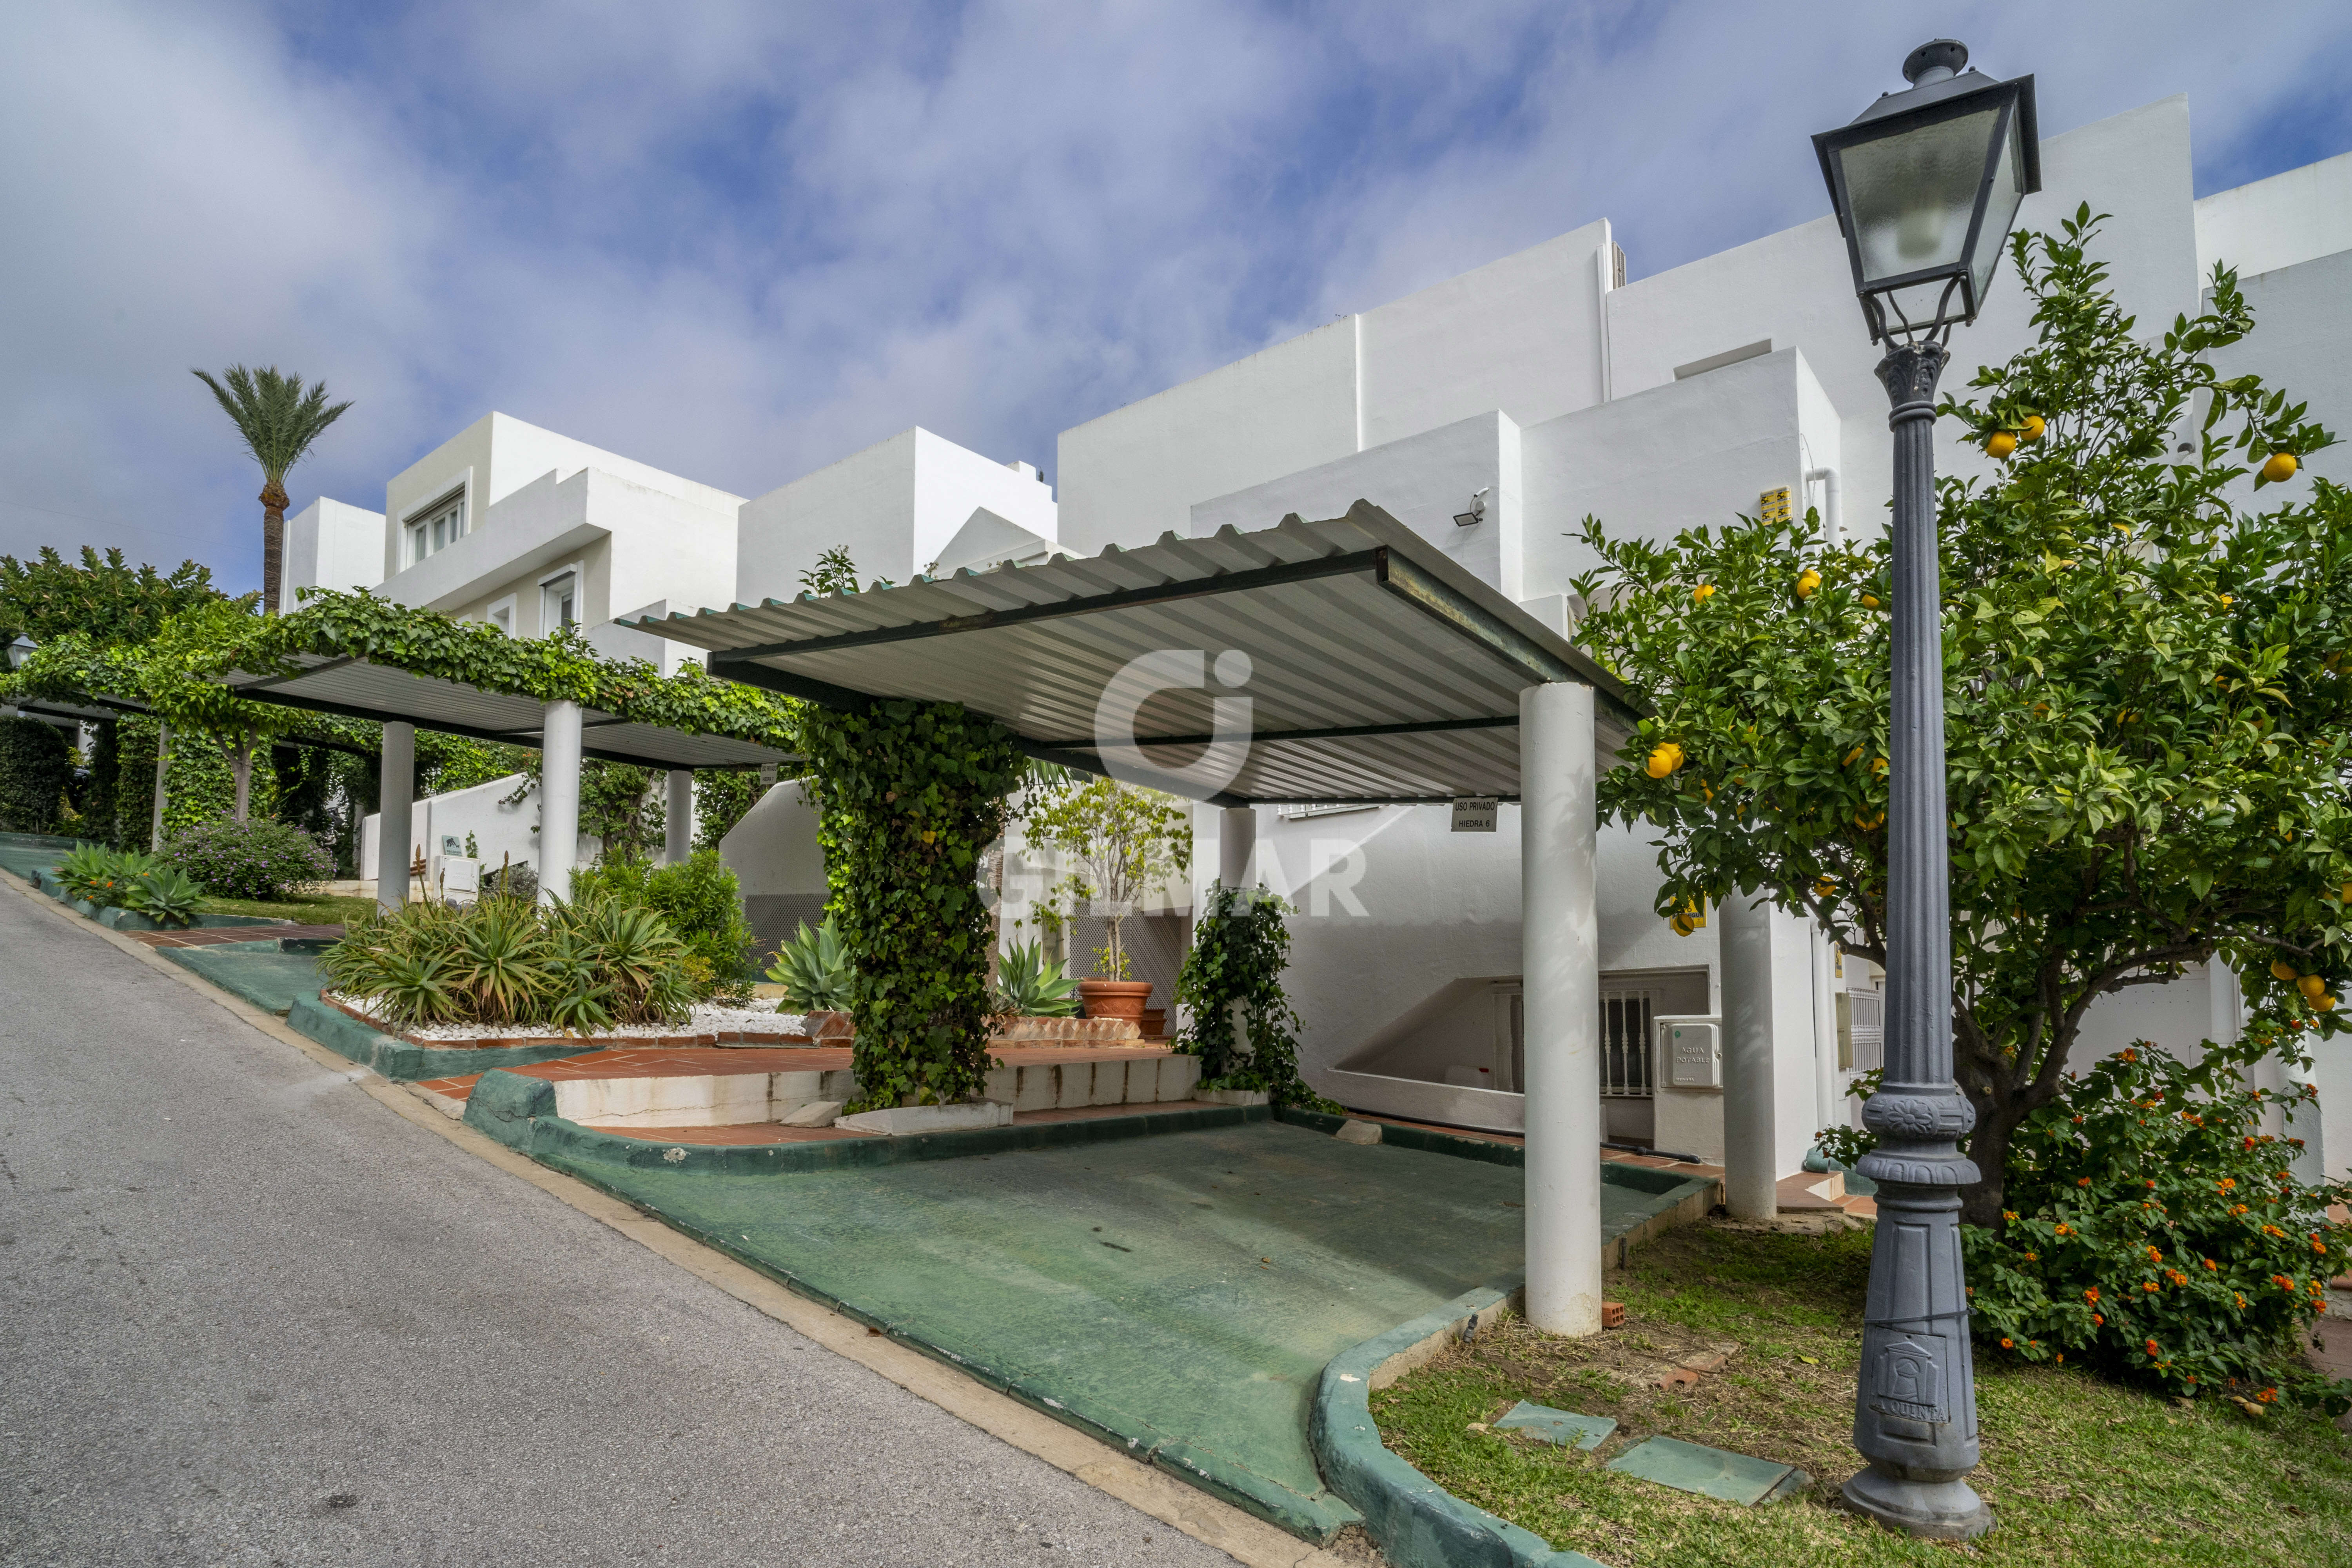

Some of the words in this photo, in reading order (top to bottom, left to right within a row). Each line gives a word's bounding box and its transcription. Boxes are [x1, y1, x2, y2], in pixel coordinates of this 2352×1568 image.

[1455, 802, 1467, 811] USO
[1469, 801, 1495, 811] PRIVADO
[1891, 1401, 1947, 1422] QUINTA
